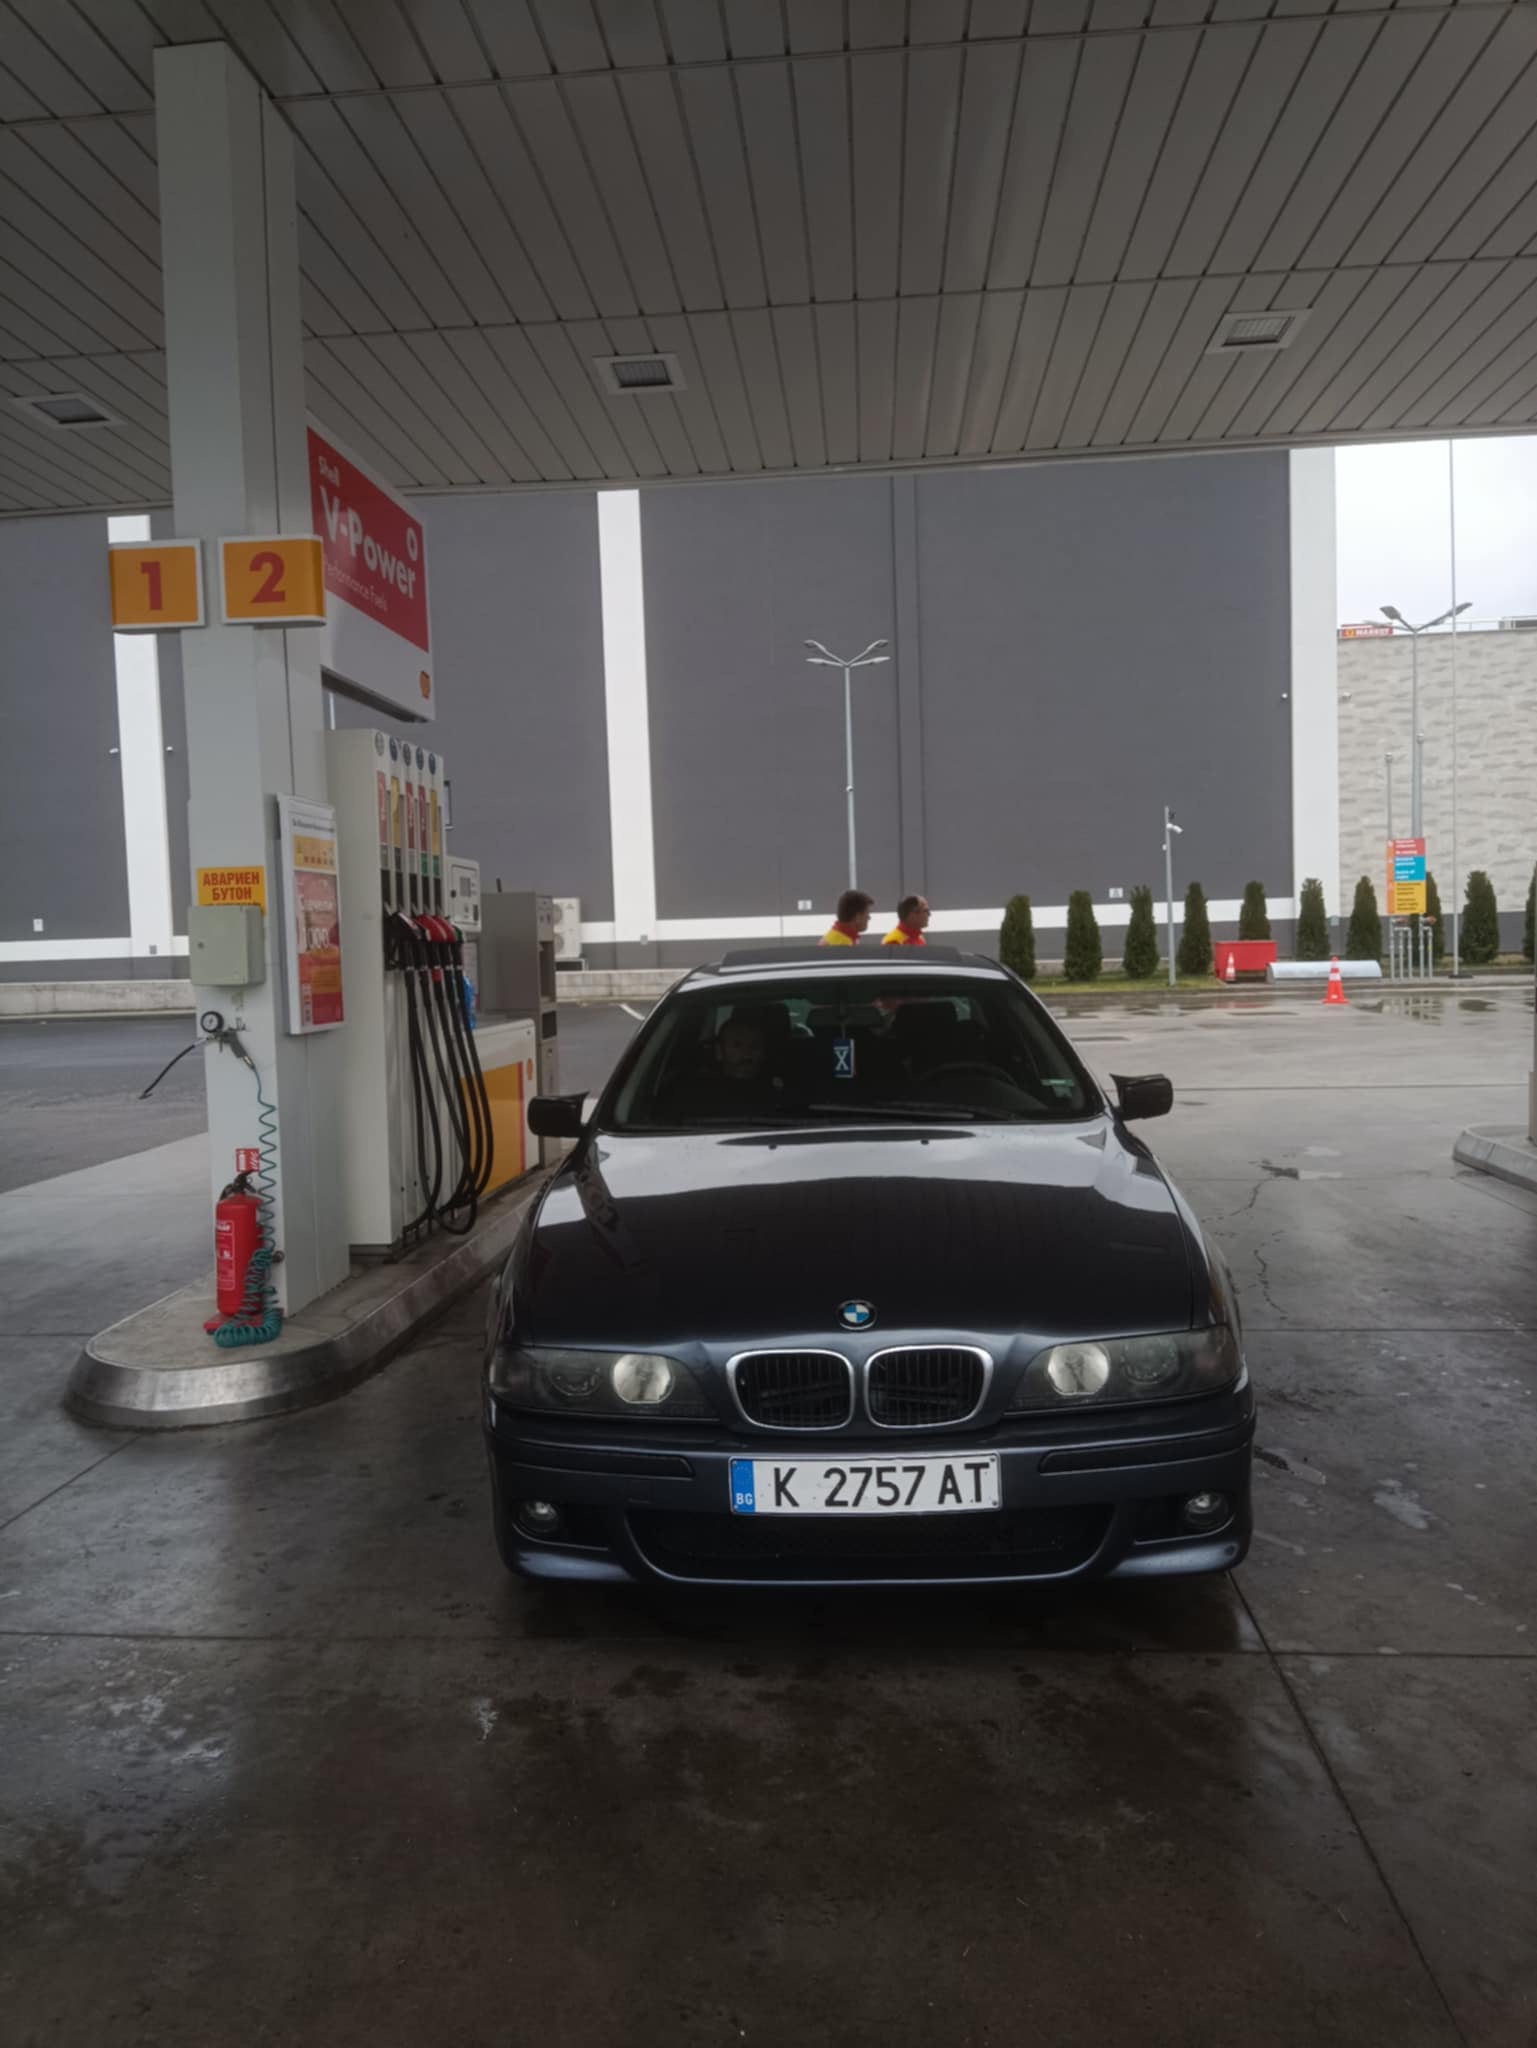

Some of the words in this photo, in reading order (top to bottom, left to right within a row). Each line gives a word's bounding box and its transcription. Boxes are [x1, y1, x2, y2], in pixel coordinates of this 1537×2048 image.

[319, 485, 416, 600] V-Power
[140, 561, 163, 611] 1
[249, 551, 286, 604] 2
[203, 871, 260, 887] АВАРИЕН
[212, 886, 252, 901] БУТОН
[735, 1492, 753, 1505] BG
[773, 1467, 800, 1507] K
[823, 1466, 926, 1507] 2757
[937, 1462, 991, 1505] AT
